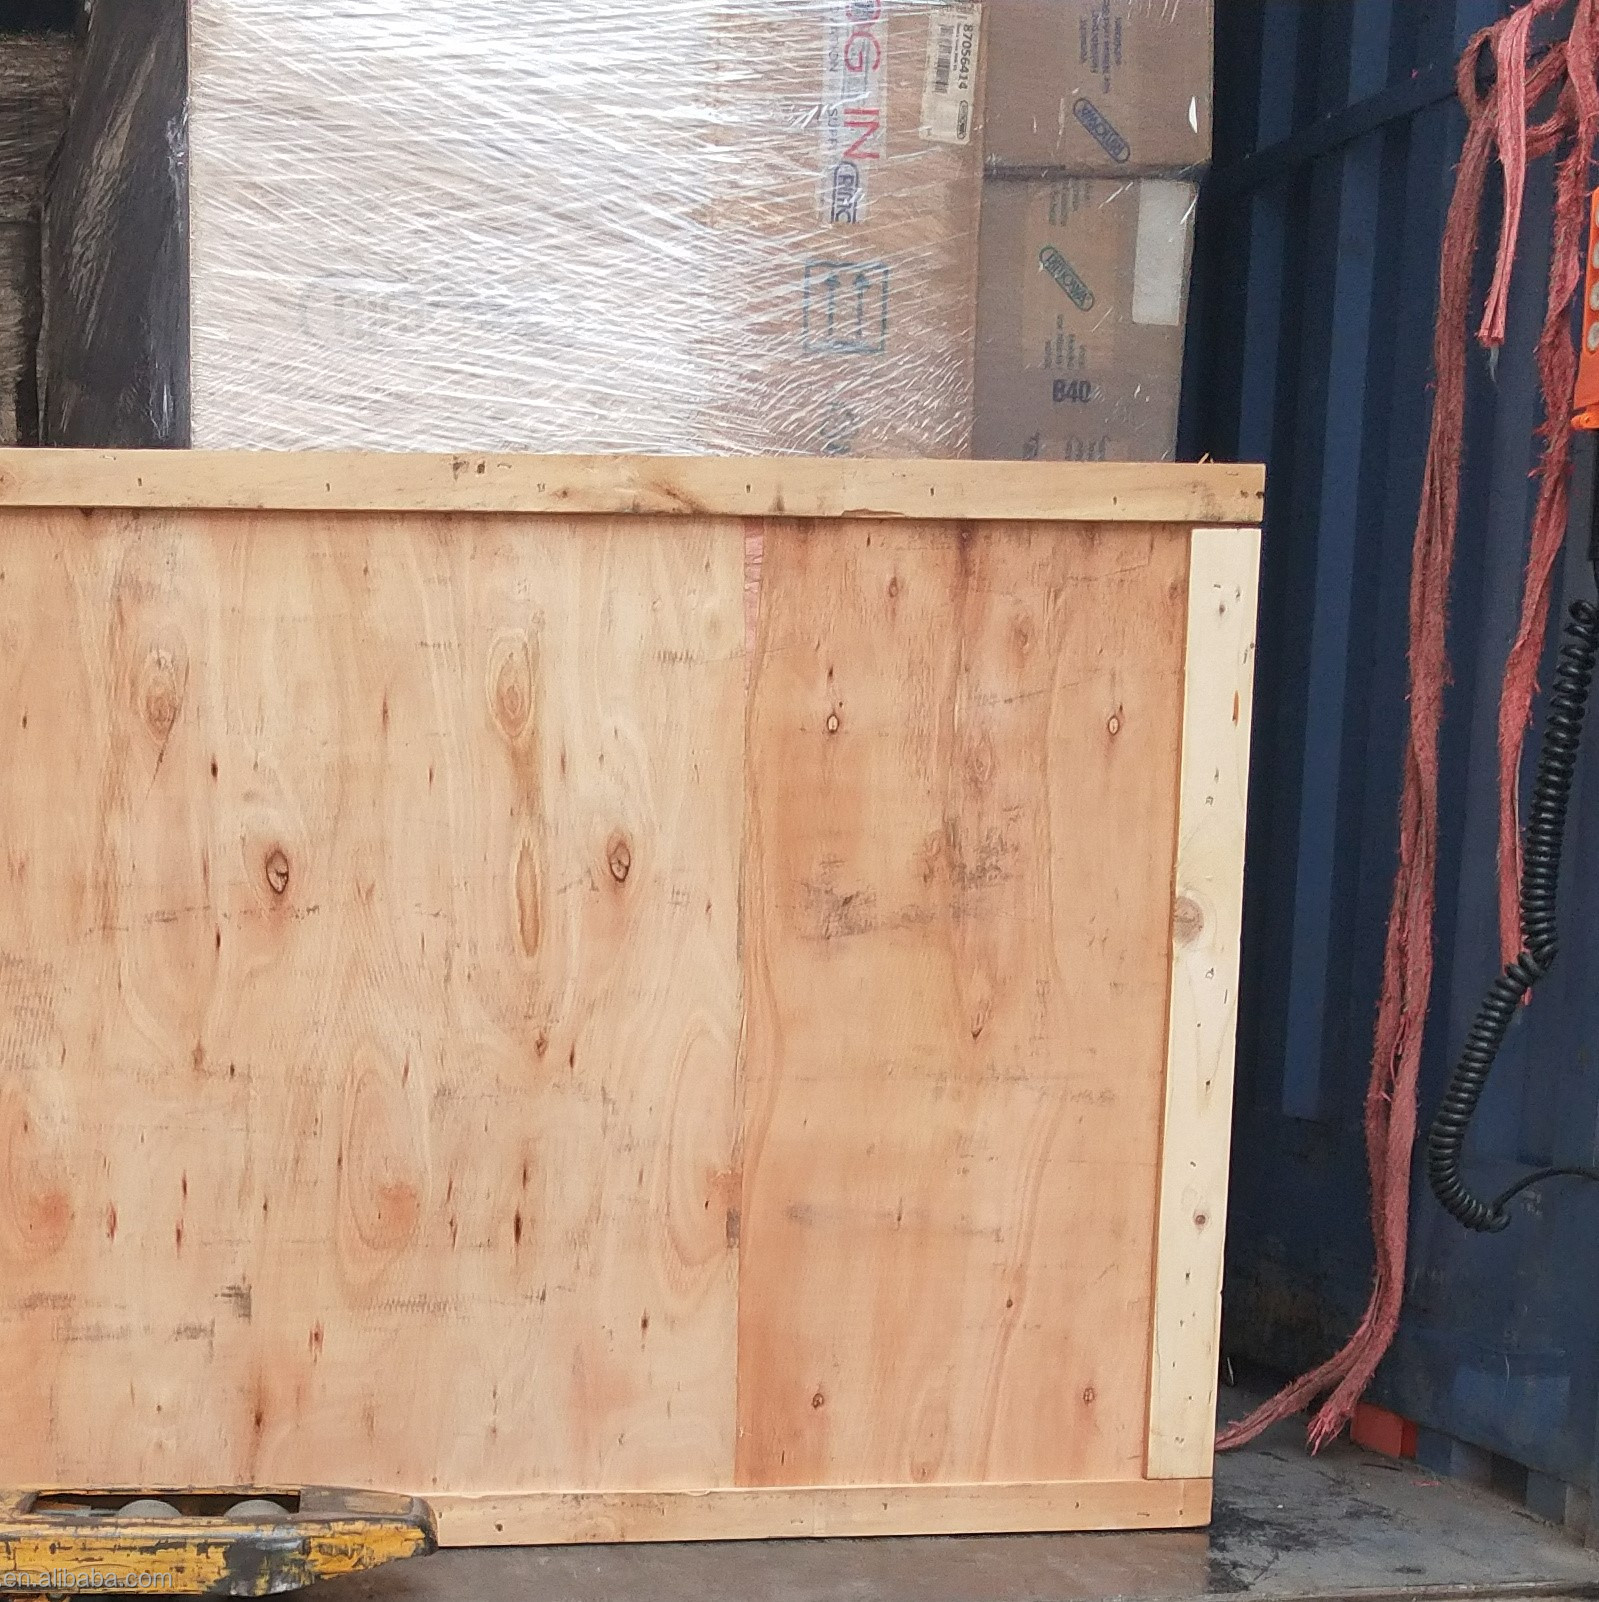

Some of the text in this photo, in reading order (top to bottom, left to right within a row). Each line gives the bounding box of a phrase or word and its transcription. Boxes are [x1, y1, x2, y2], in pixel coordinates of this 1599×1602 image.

[957, 24, 974, 91] 87056414
[842, 108, 881, 159] IN
[1053, 379, 1092, 403] B40
